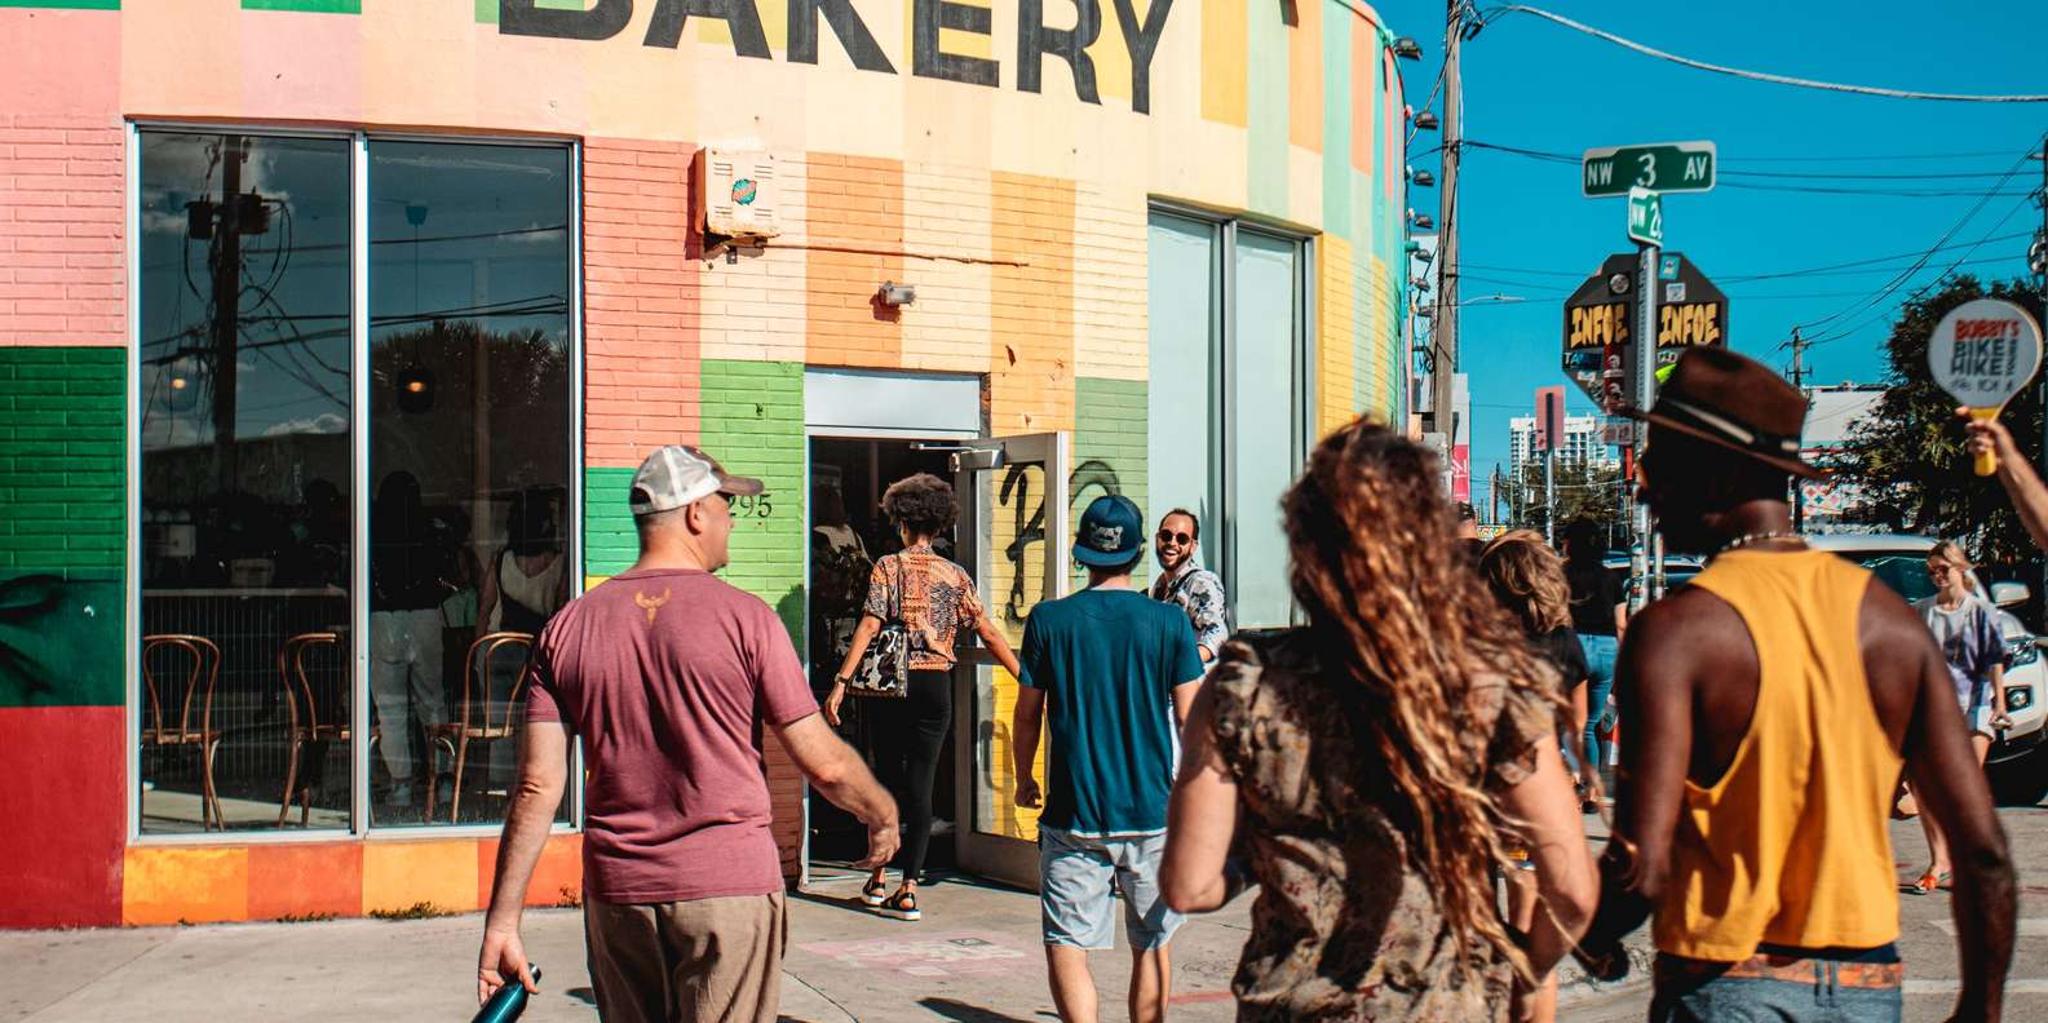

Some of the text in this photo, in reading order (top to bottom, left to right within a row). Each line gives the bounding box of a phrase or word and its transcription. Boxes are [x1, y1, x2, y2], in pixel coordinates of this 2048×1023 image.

[499, 0, 1174, 115] KERY
[1587, 152, 1708, 187] NW 3 AV
[1631, 203, 1646, 228] NW
[1658, 303, 1720, 347] INFOE
[1953, 338, 2005, 358] BIKE
[1950, 357, 2003, 376] HIKE
